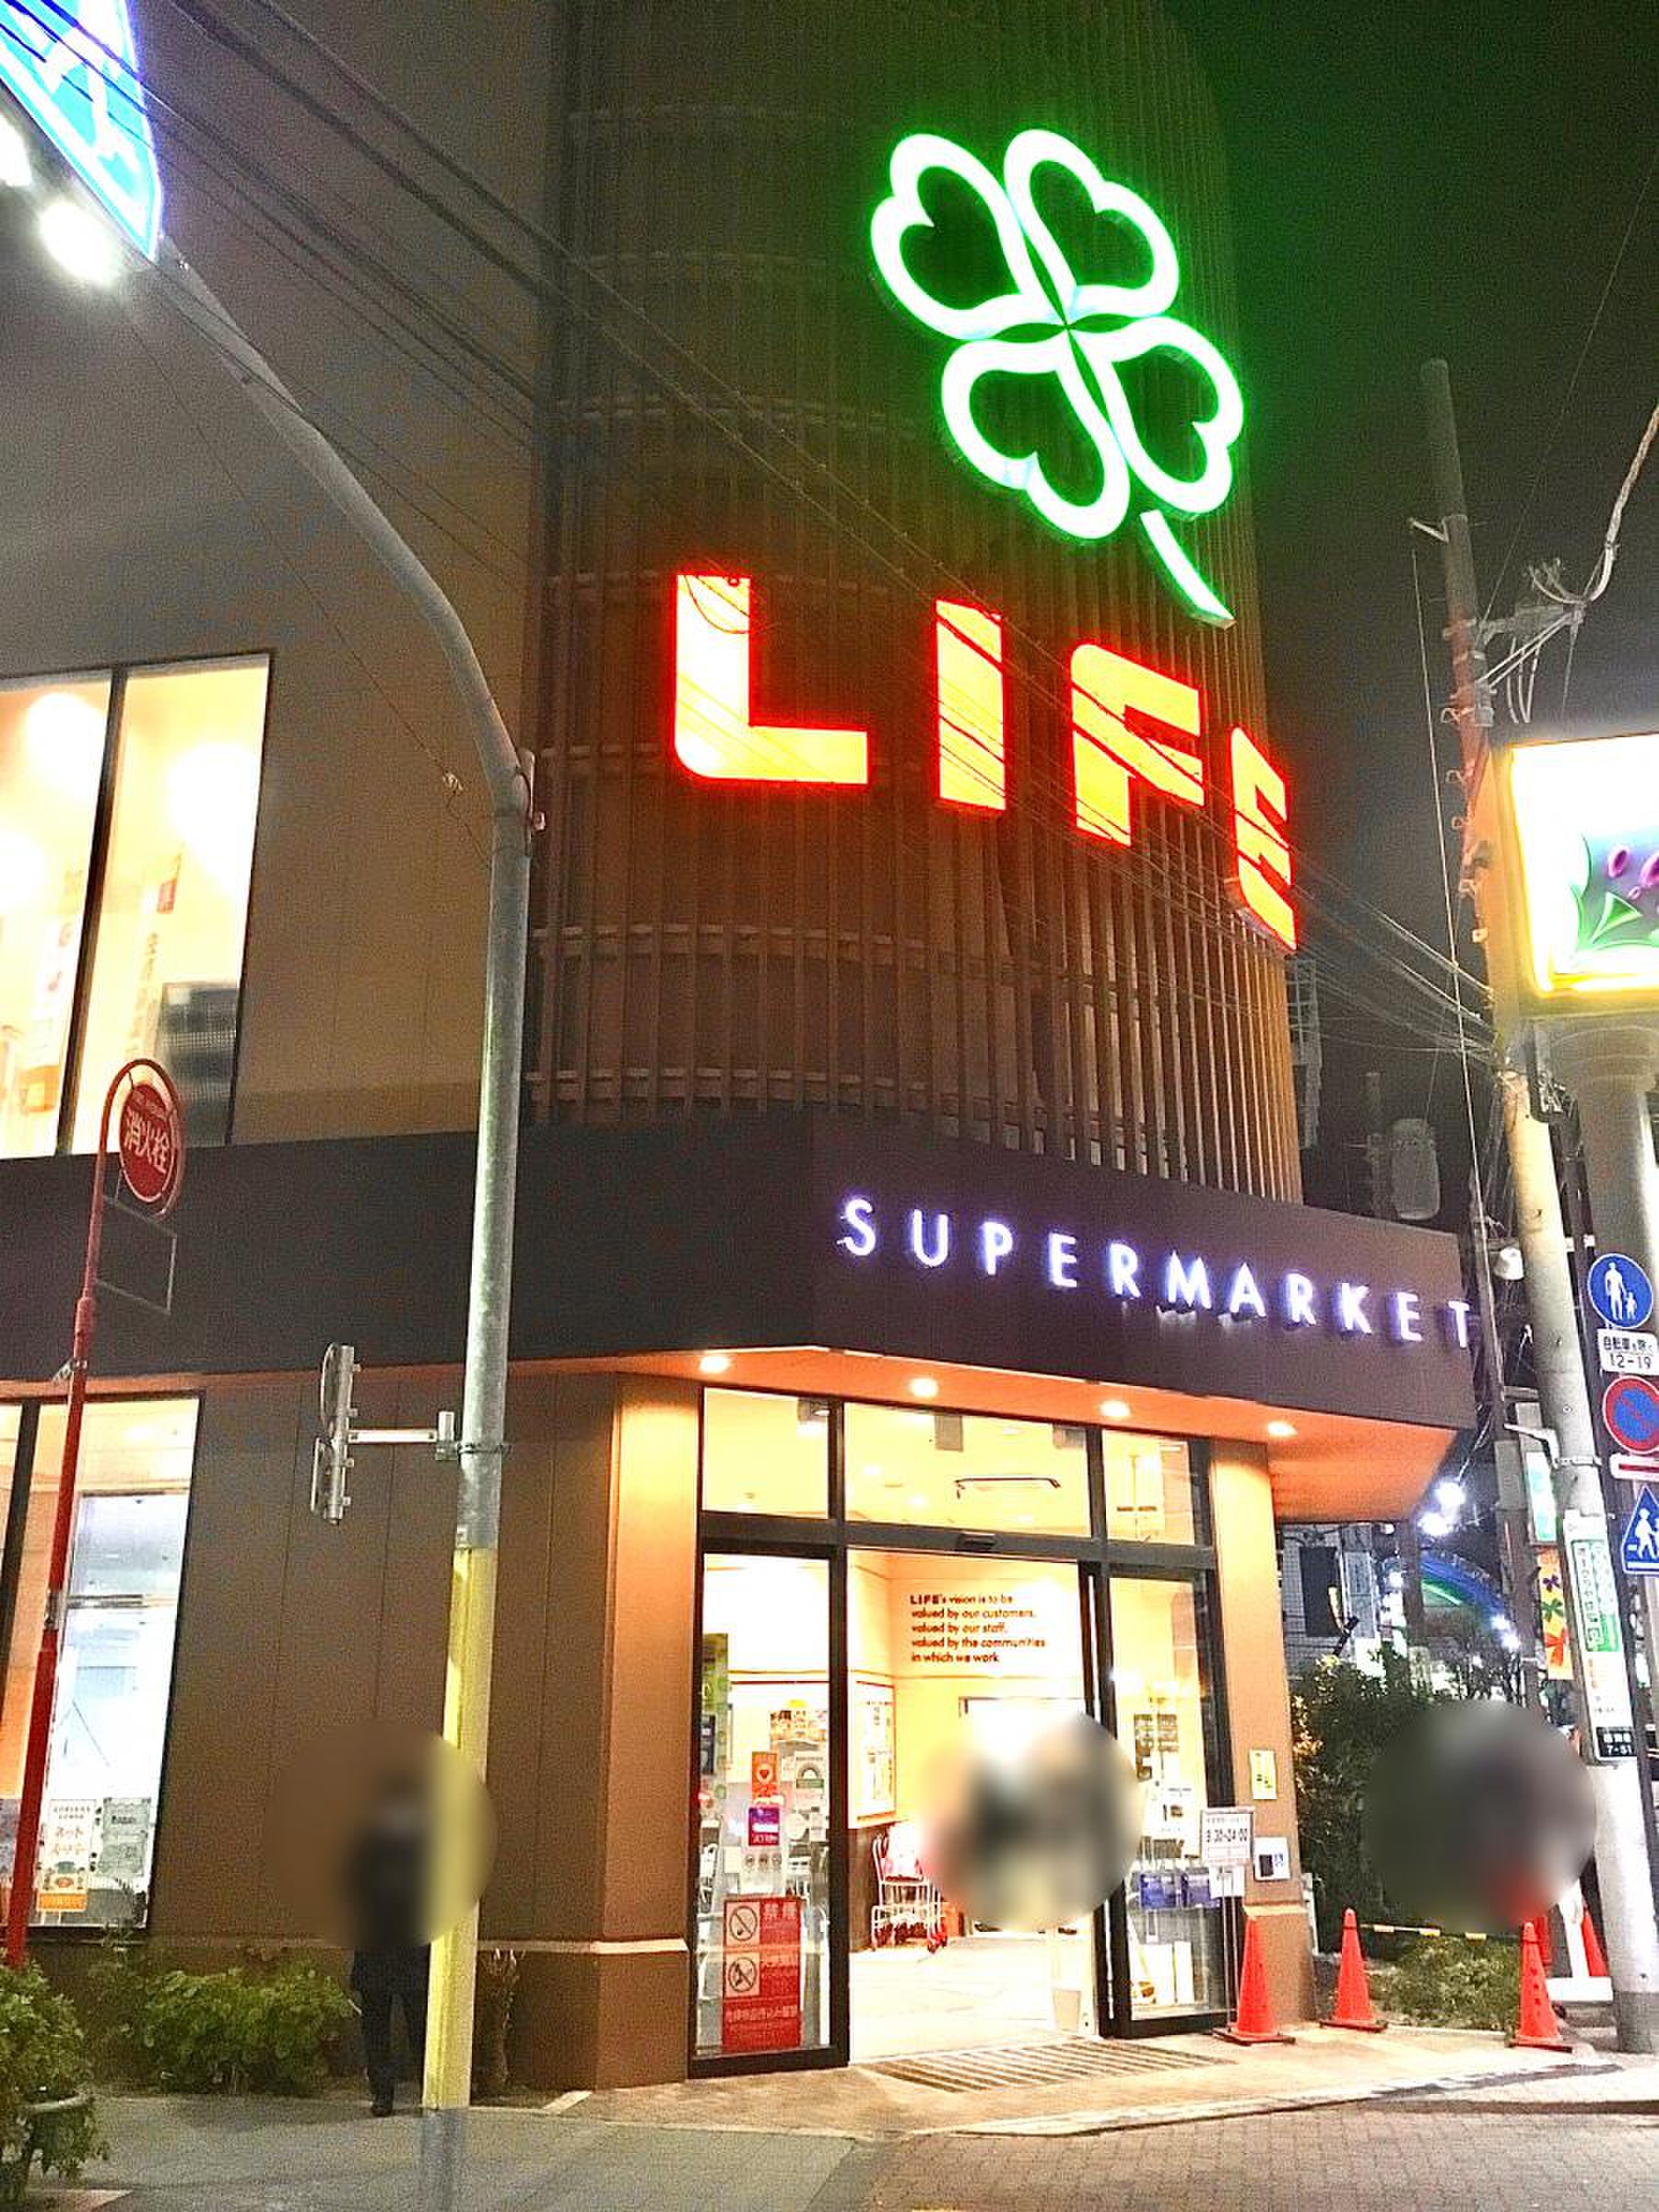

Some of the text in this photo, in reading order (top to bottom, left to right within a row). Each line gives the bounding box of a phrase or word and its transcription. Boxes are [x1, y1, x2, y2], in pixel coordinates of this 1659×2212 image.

[674, 573, 1297, 950] LIFE
[123, 1104, 170, 1174] 消火栓
[841, 1196, 1472, 1348] SUPERMARKET
[1609, 1353, 1653, 1370] 12-19
[949, 1594, 976, 1605] vision
[978, 1594, 986, 1605] is
[1001, 1594, 1014, 1605] be
[912, 1607, 945, 1618] valued
[947, 1607, 959, 1620] by
[962, 1609, 980, 1619] our
[912, 1622, 945, 1633] valued
[947, 1622, 959, 1635] by
[962, 1624, 980, 1634] our
[912, 1637, 1045, 1650] valued by the communities
[912, 1652, 922, 1663] in
[924, 1652, 953, 1663] which
[956, 1653, 971, 1663] we
